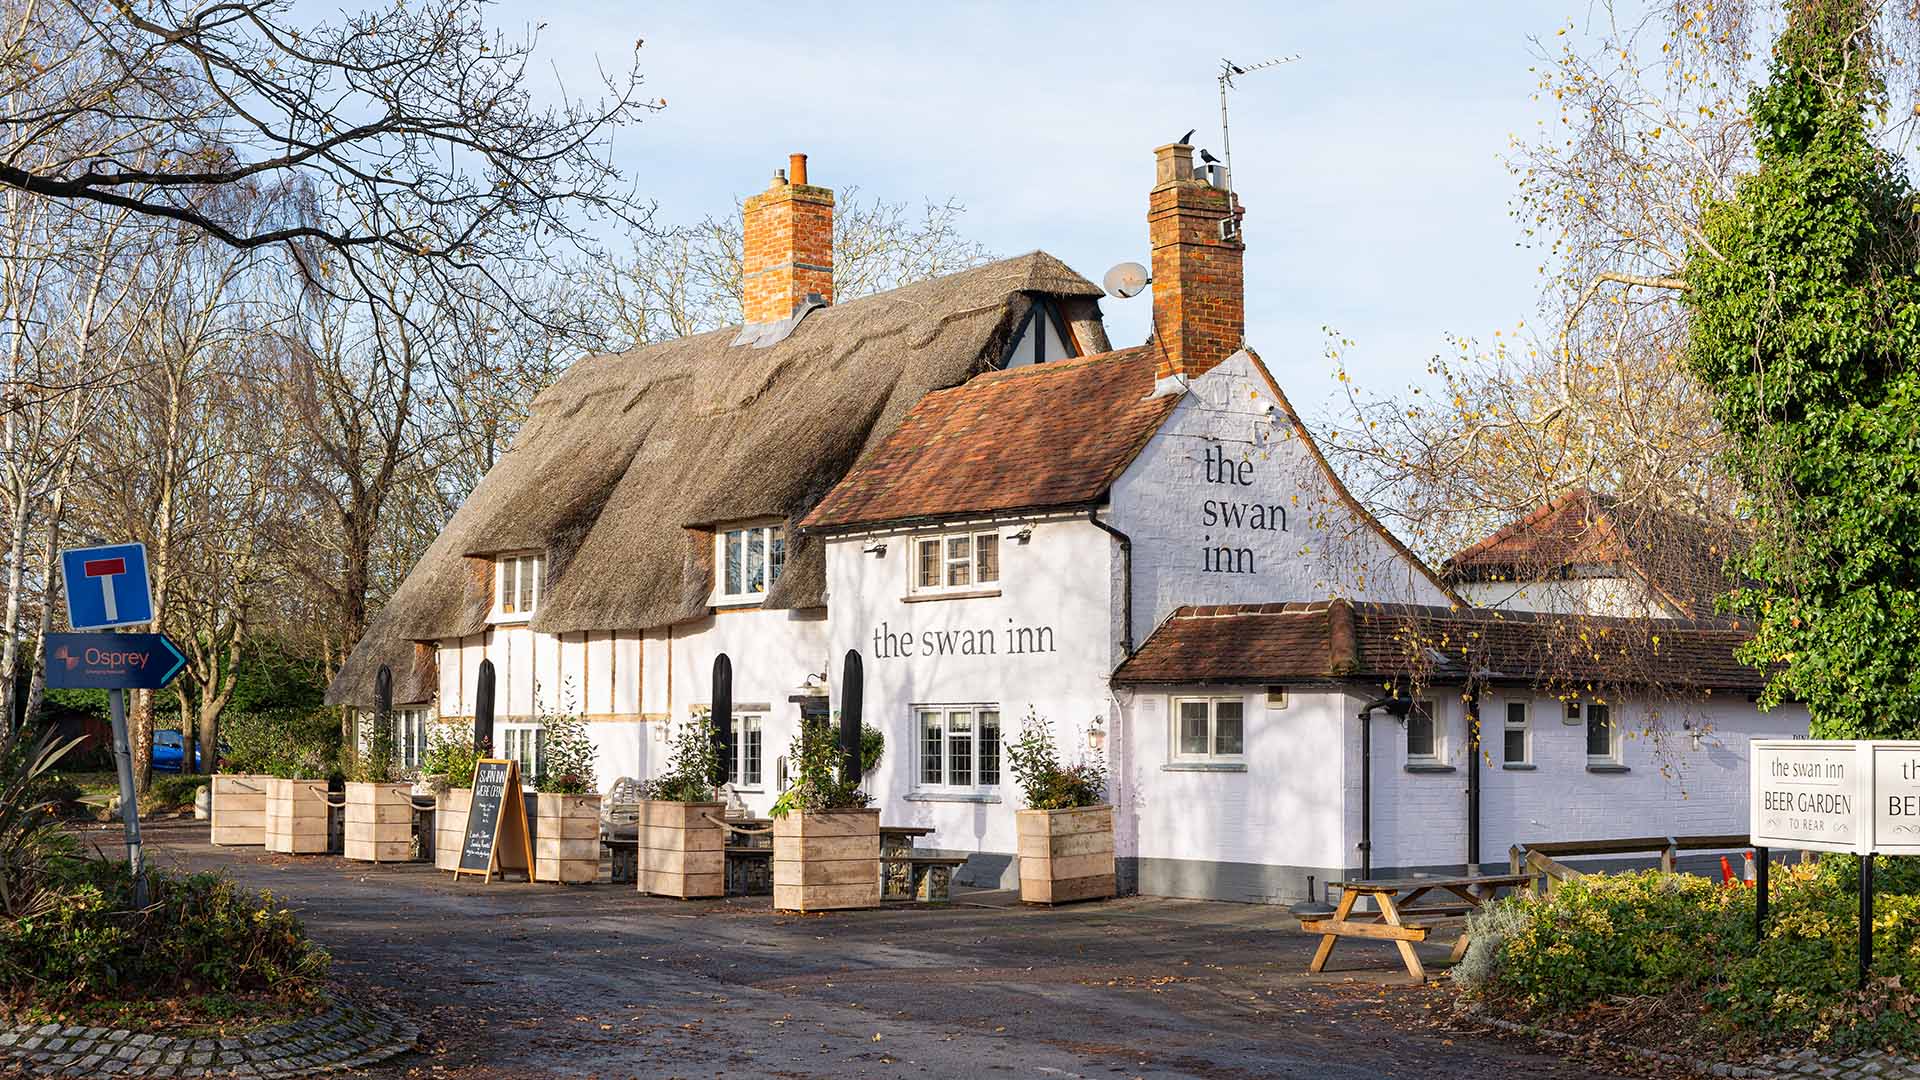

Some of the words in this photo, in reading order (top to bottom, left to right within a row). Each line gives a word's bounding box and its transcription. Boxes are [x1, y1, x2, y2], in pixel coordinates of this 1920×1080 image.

[1204, 445, 1254, 486] the
[1202, 500, 1289, 532] swan
[1202, 534, 1257, 575] inn
[873, 621, 914, 659] the
[921, 628, 997, 657] swan
[1005, 617, 1057, 655] inn
[84, 647, 150, 670] Osprey
[1771, 756, 1790, 777] the
[1792, 761, 1822, 778] swan
[1825, 757, 1844, 779] inn
[1764, 791, 1794, 811] BEER
[1797, 792, 1852, 815] GARDEN
[1889, 795, 1920, 816] BE
[1789, 818, 1799, 830] TO
[1802, 818, 1825, 831] REAR
